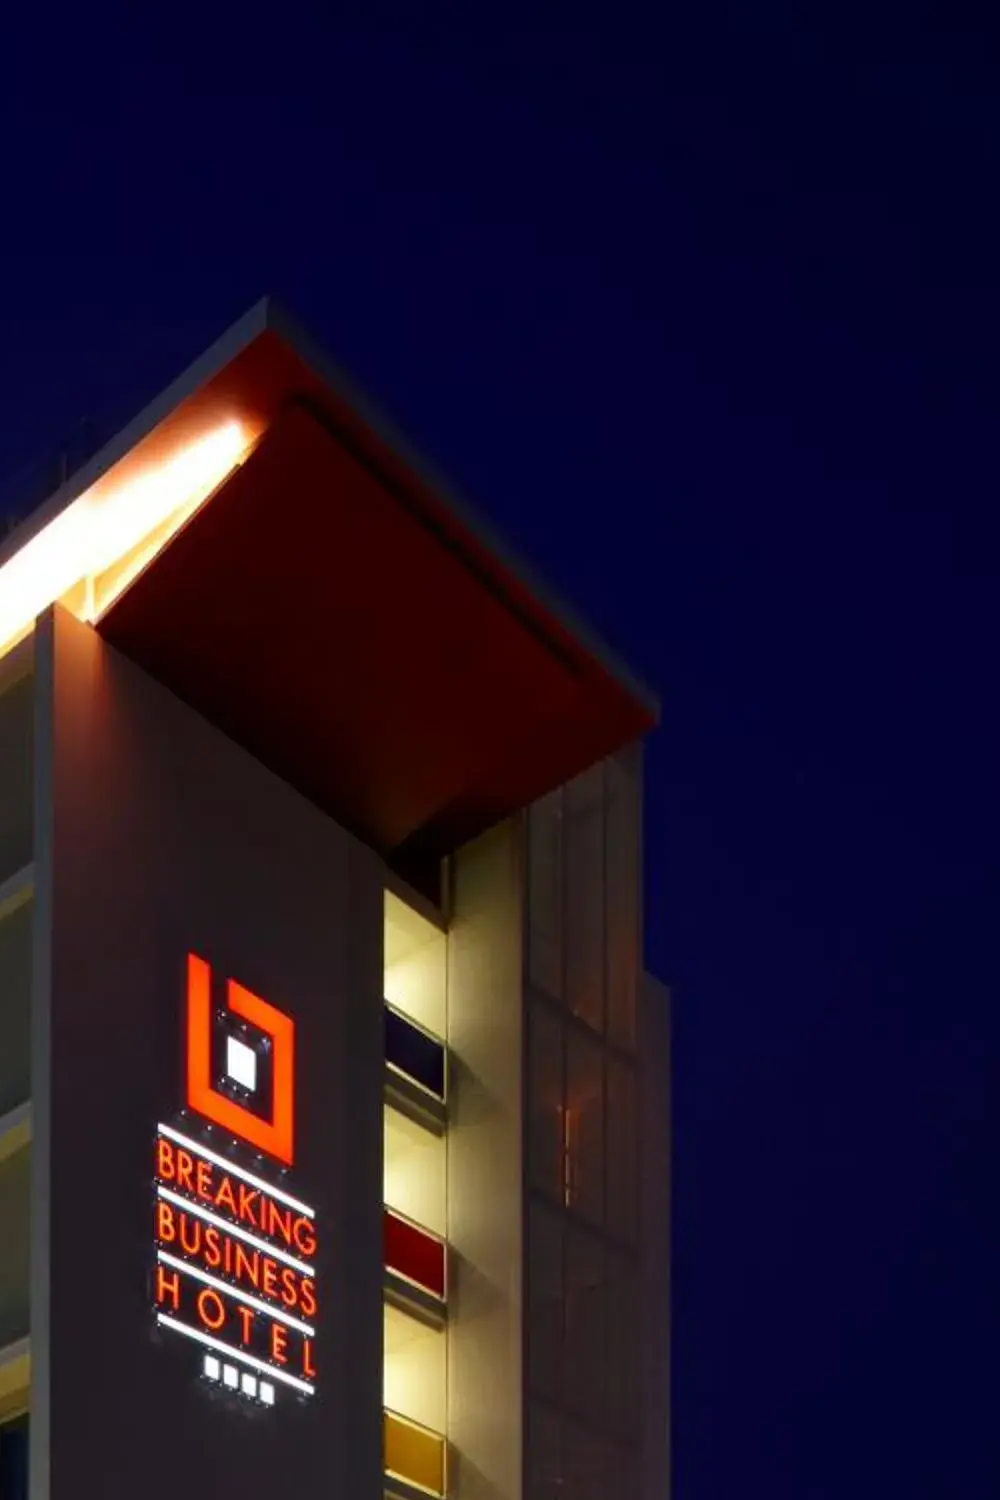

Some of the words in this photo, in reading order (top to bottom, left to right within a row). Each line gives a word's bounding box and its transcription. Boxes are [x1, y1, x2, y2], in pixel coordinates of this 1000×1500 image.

[156, 1138, 317, 1256] BREAKING
[156, 1202, 317, 1317] BUSINESS
[156, 1267, 317, 1378] HOTEL
